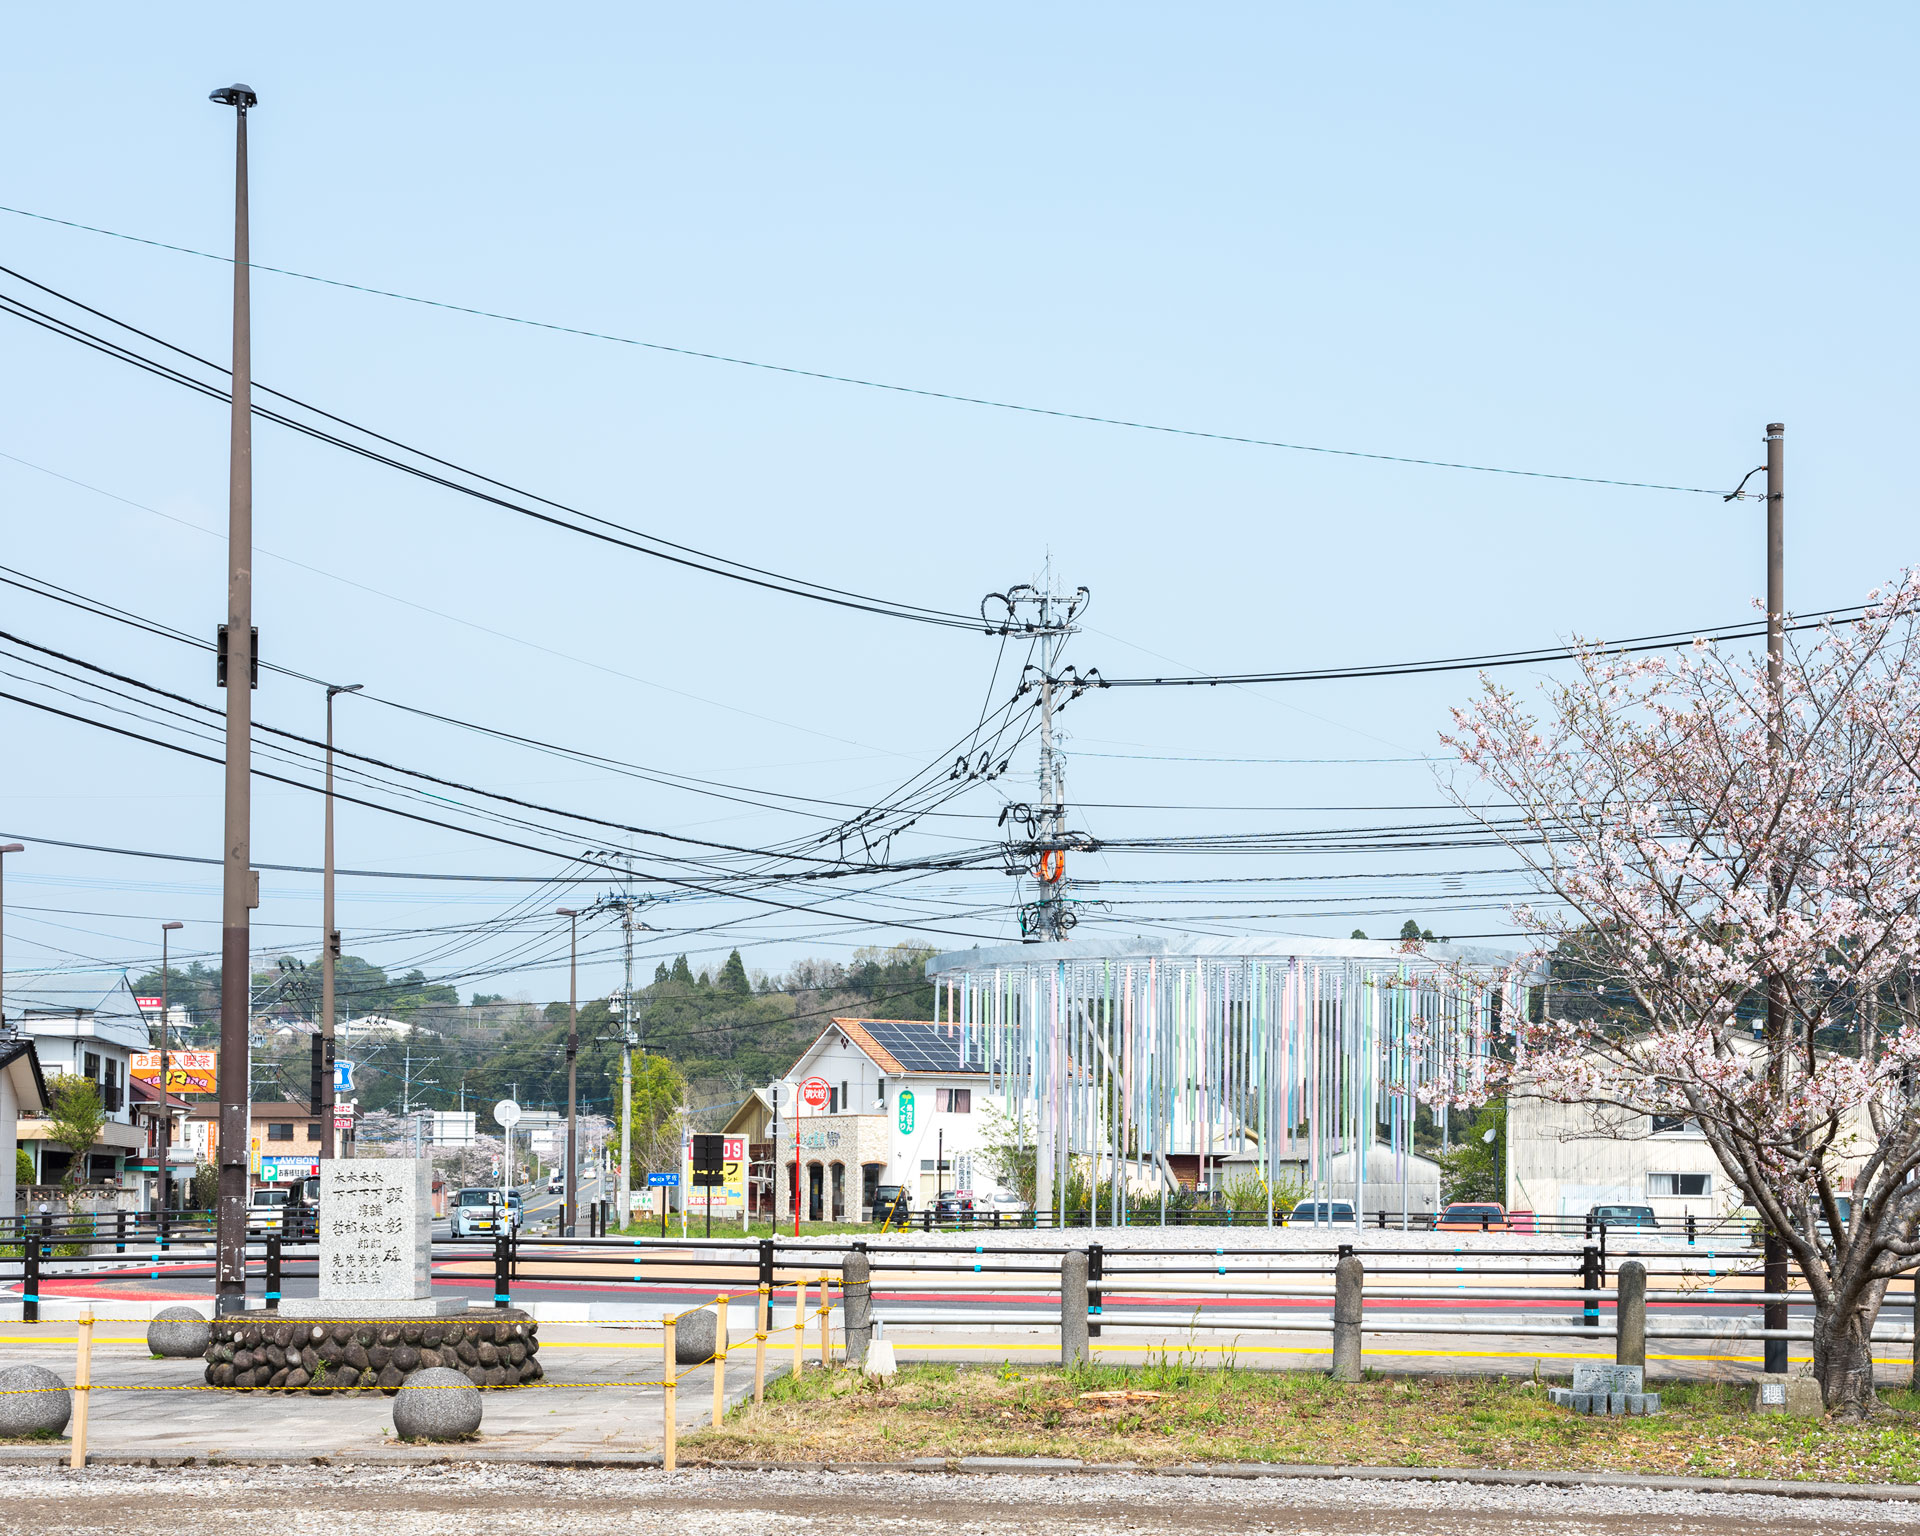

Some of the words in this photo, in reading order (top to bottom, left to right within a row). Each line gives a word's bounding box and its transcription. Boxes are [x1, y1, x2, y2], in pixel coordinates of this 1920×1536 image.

[805, 1089, 825, 1099] 消火栓
[263, 1166, 276, 1180] P
[1763, 1385, 1783, 1402] 櫻
